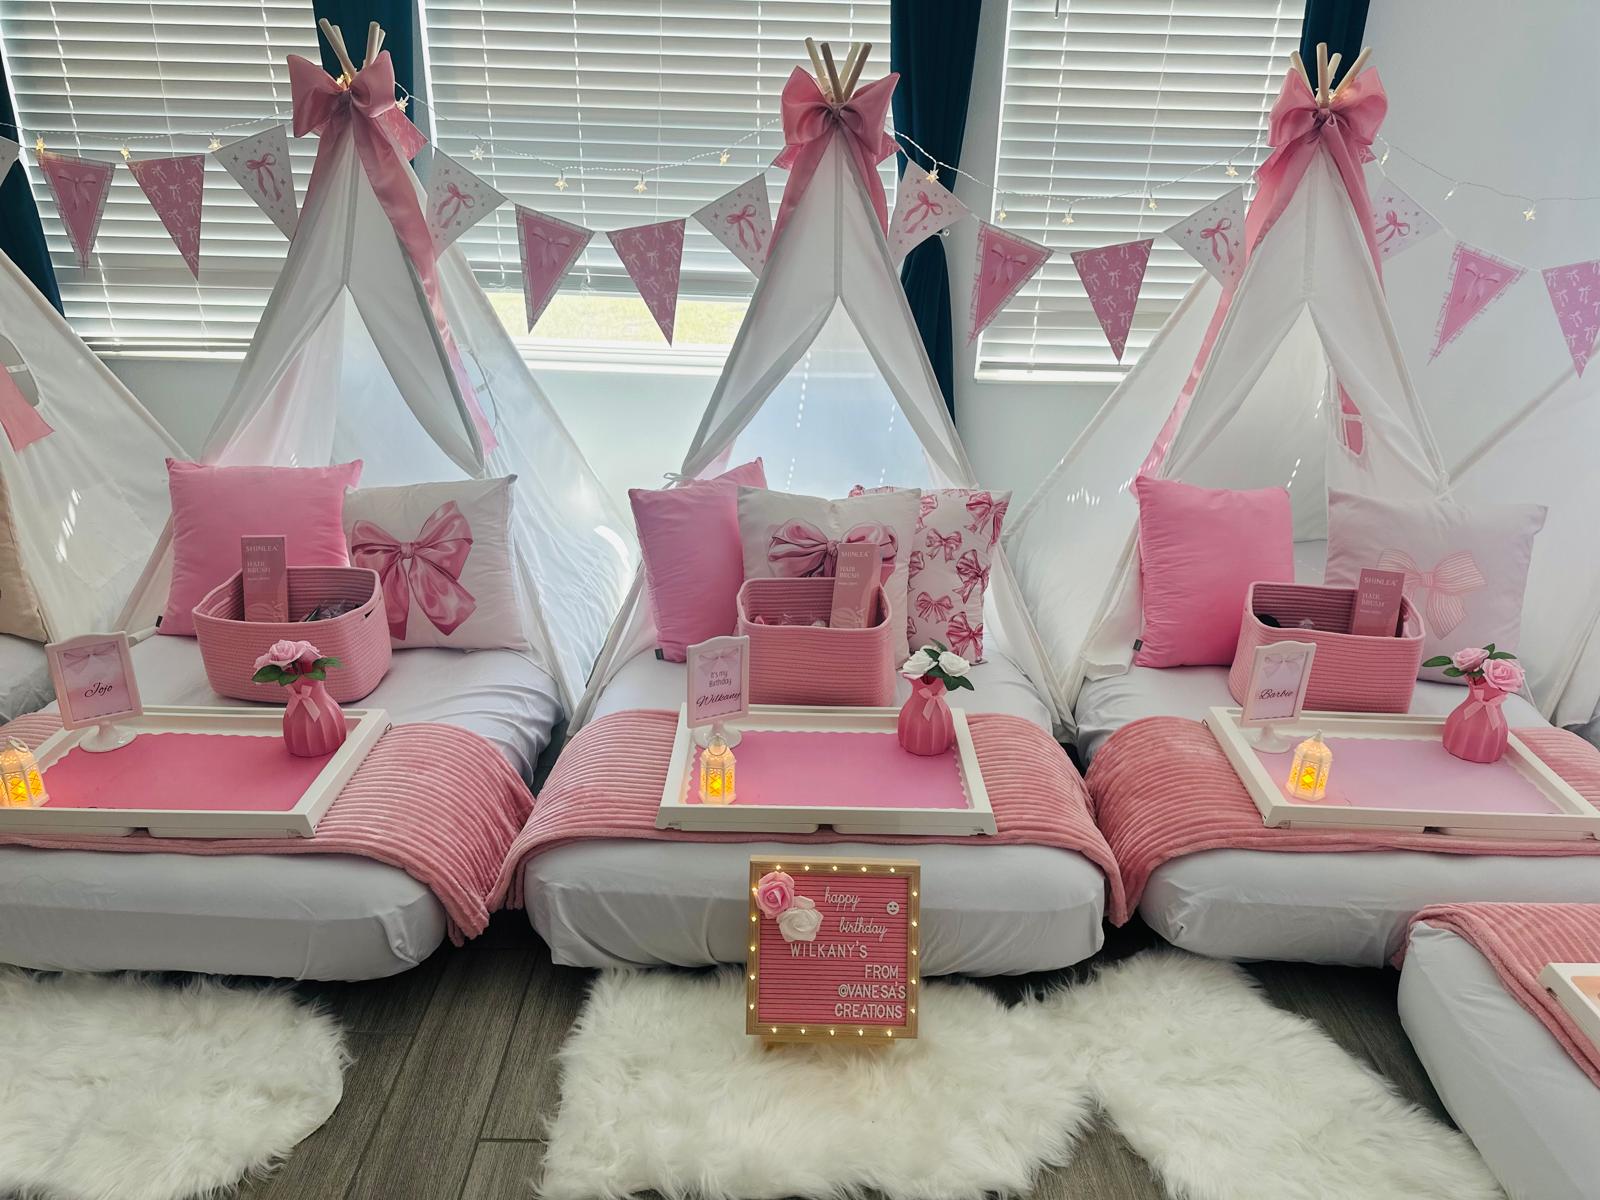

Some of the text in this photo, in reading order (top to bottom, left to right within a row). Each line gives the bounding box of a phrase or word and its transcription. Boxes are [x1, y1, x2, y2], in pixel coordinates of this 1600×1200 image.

[84, 682, 113, 698] Jojo
[1259, 688, 1294, 700] Barbie
[696, 692, 742, 708] Wilkany
[824, 886, 860, 912] happy
[838, 916, 888, 942] birthday
[790, 941, 868, 959] WILKANY'S
[865, 964, 899, 979] FROM
[838, 981, 906, 999] @VANESA'S
[834, 1003, 903, 1019] CREATIONS
